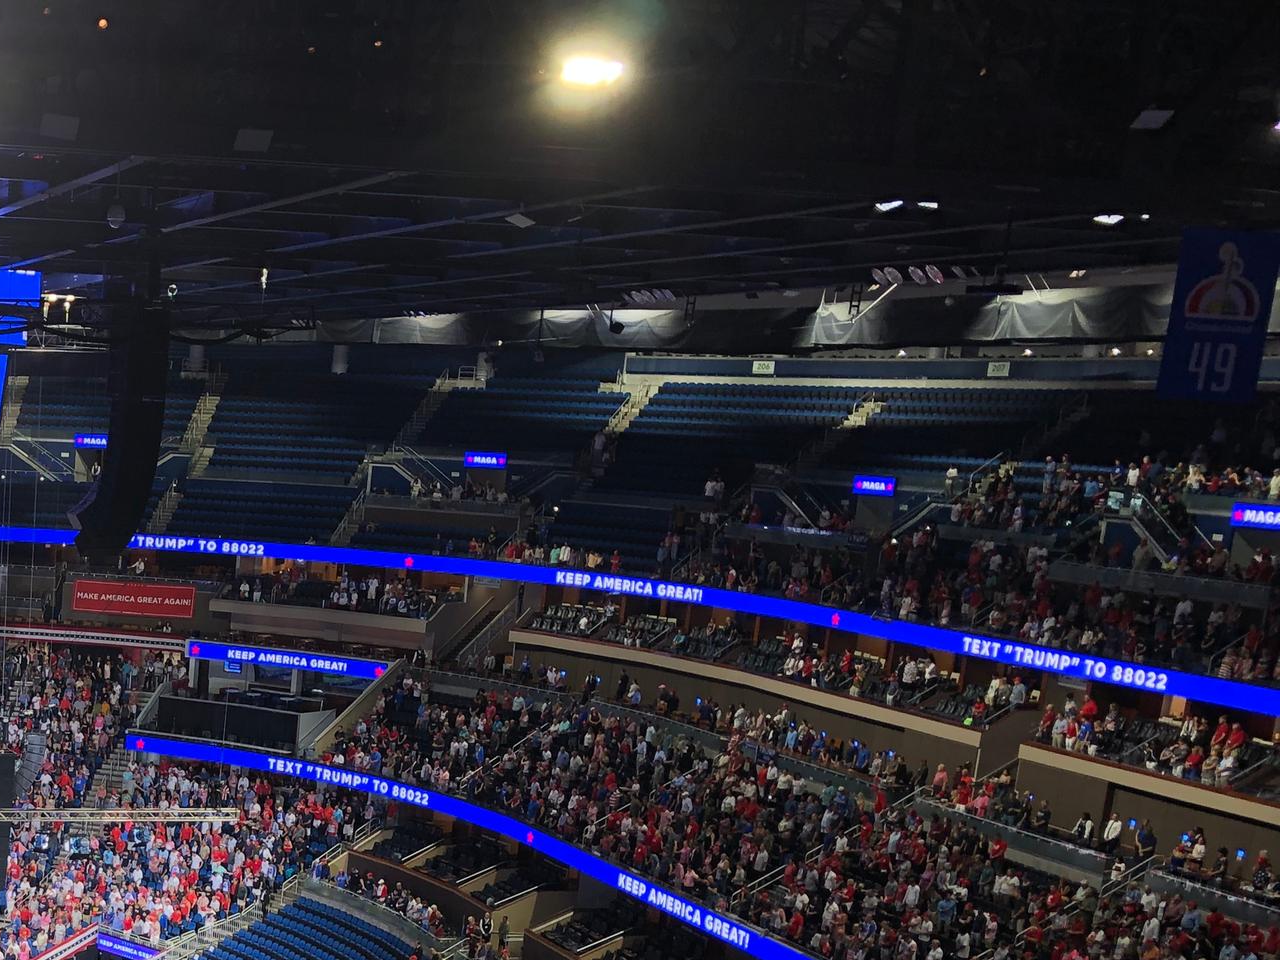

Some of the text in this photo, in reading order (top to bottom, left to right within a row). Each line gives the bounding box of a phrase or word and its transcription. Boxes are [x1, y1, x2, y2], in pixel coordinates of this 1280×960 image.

[1188, 341, 1237, 393] 49
[83, 437, 108, 446] MAGA
[473, 455, 498, 465] MAGA
[861, 480, 886, 491] MAGA
[198, 540, 218, 552] TO
[222, 542, 266, 556] 88022
[76, 591, 191, 606] MAKE AMERICA GREAT AGAIN!
[556, 571, 704, 603] KEEP AMERICA GREAT!
[227, 649, 348, 672] KEEP AMERICA GREAT!
[963, 636, 1002, 658] TEXT
[1084, 659, 1107, 678] TO
[1111, 665, 1169, 690] 88022
[267, 758, 303, 776] TEXT
[372, 779, 390, 794] TO
[392, 785, 430, 806] 88022
[617, 872, 750, 949] KEEP AMERICA GREAT!
